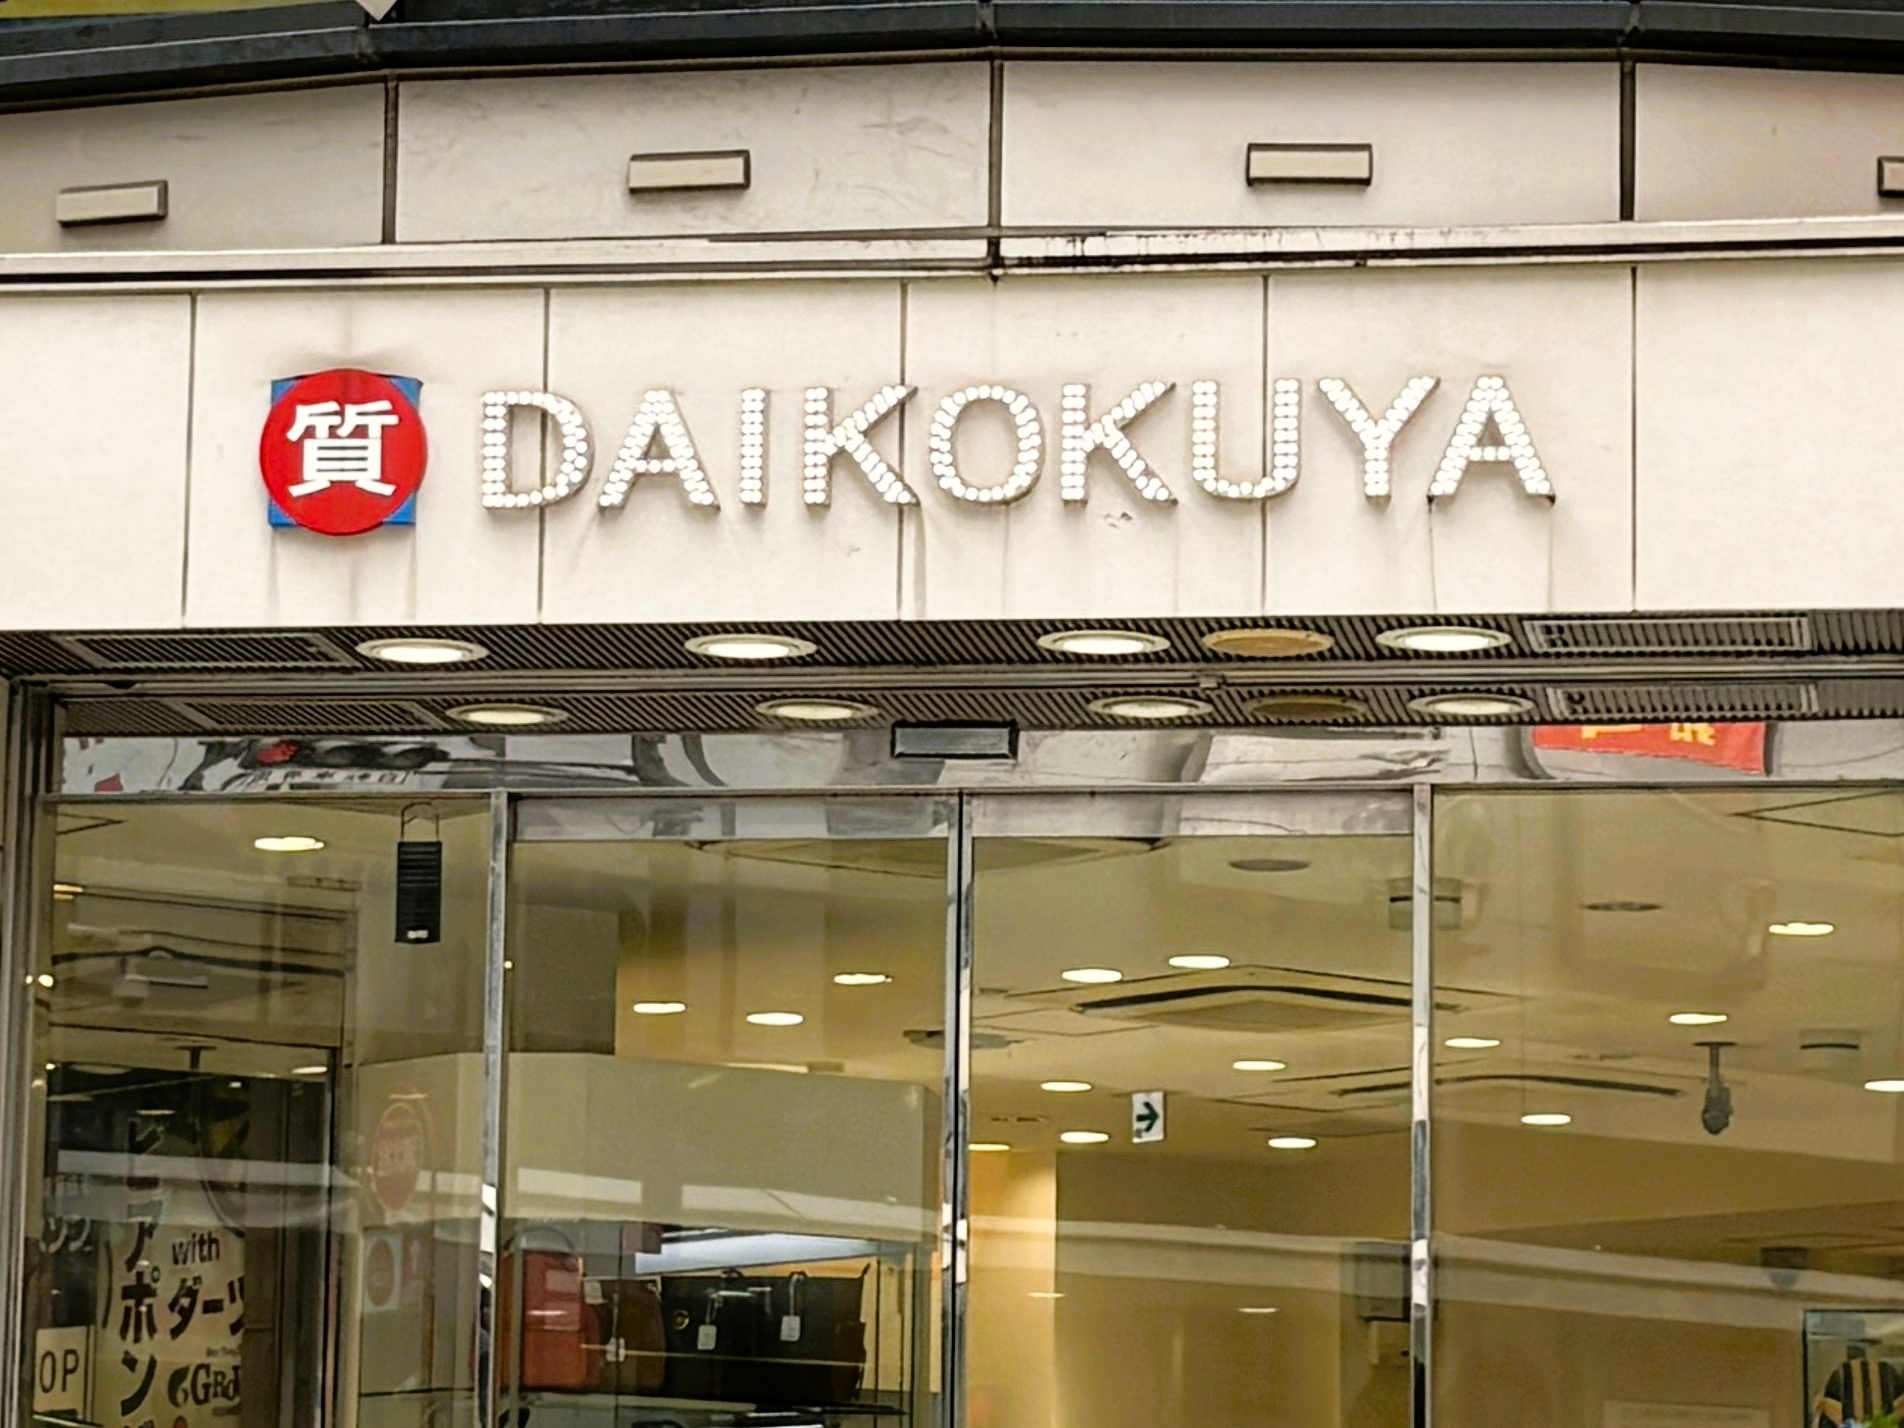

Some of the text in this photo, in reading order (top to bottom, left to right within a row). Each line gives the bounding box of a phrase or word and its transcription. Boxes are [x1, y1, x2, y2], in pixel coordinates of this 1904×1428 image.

[285, 402, 401, 500] 質
[477, 373, 1557, 512] DAIKOKUYA
[171, 1231, 221, 1266] with
